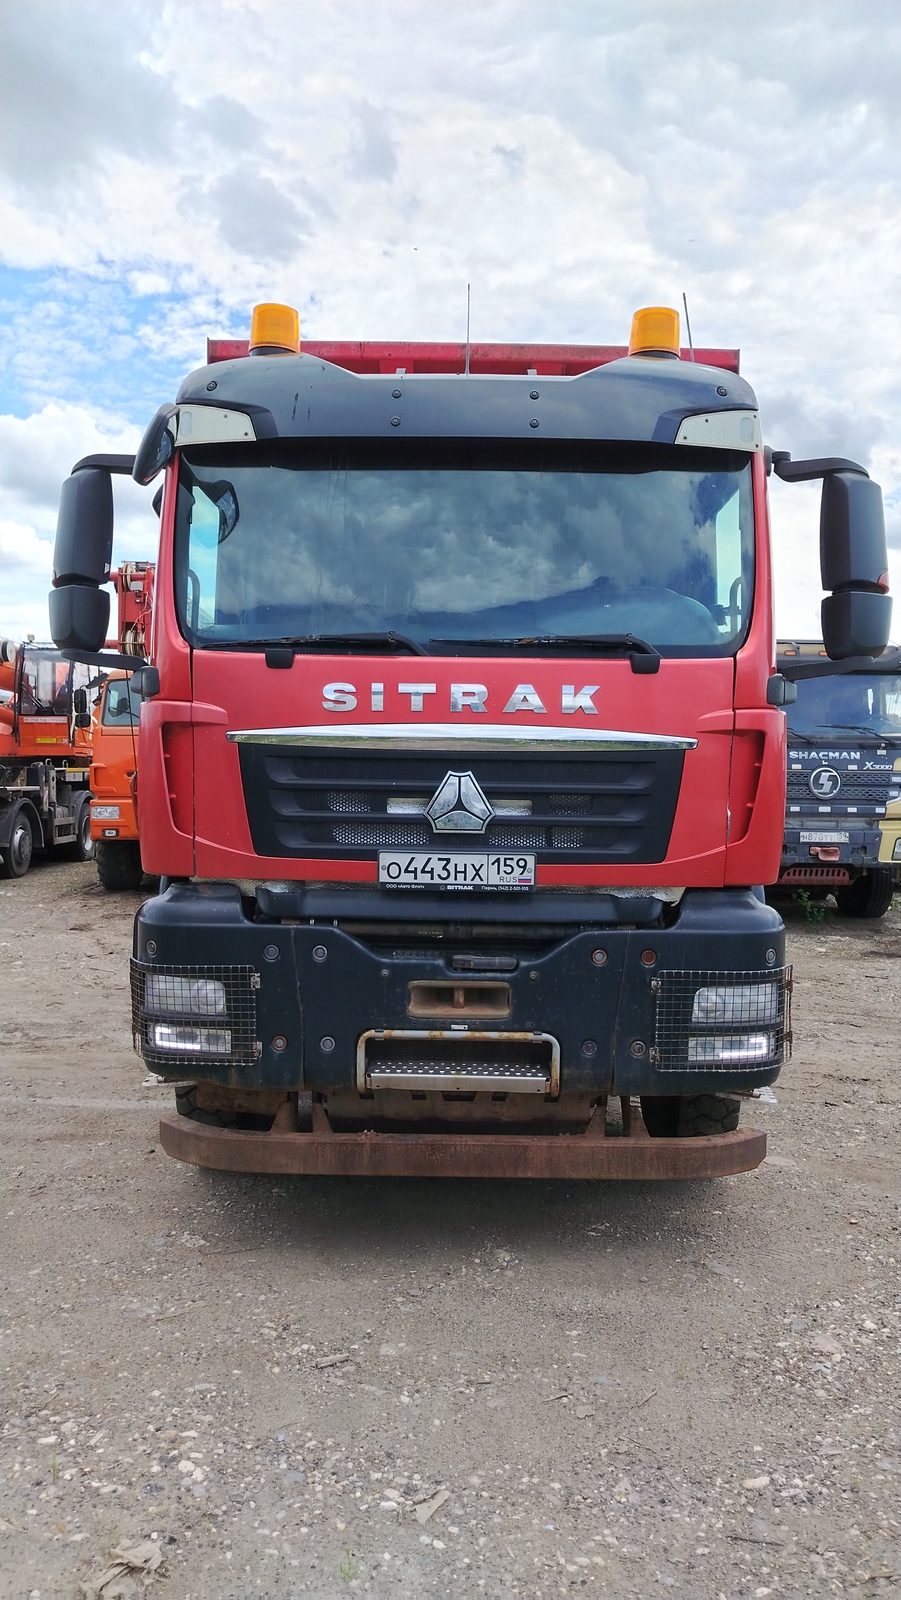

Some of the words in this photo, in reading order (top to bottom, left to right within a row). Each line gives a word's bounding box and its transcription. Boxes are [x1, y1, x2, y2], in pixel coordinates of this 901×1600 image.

[321, 682, 600, 714] SITRAK
[788, 751, 860, 760] SHACMAN
[863, 761, 893, 770] X3000
[490, 857, 528, 876] 159
